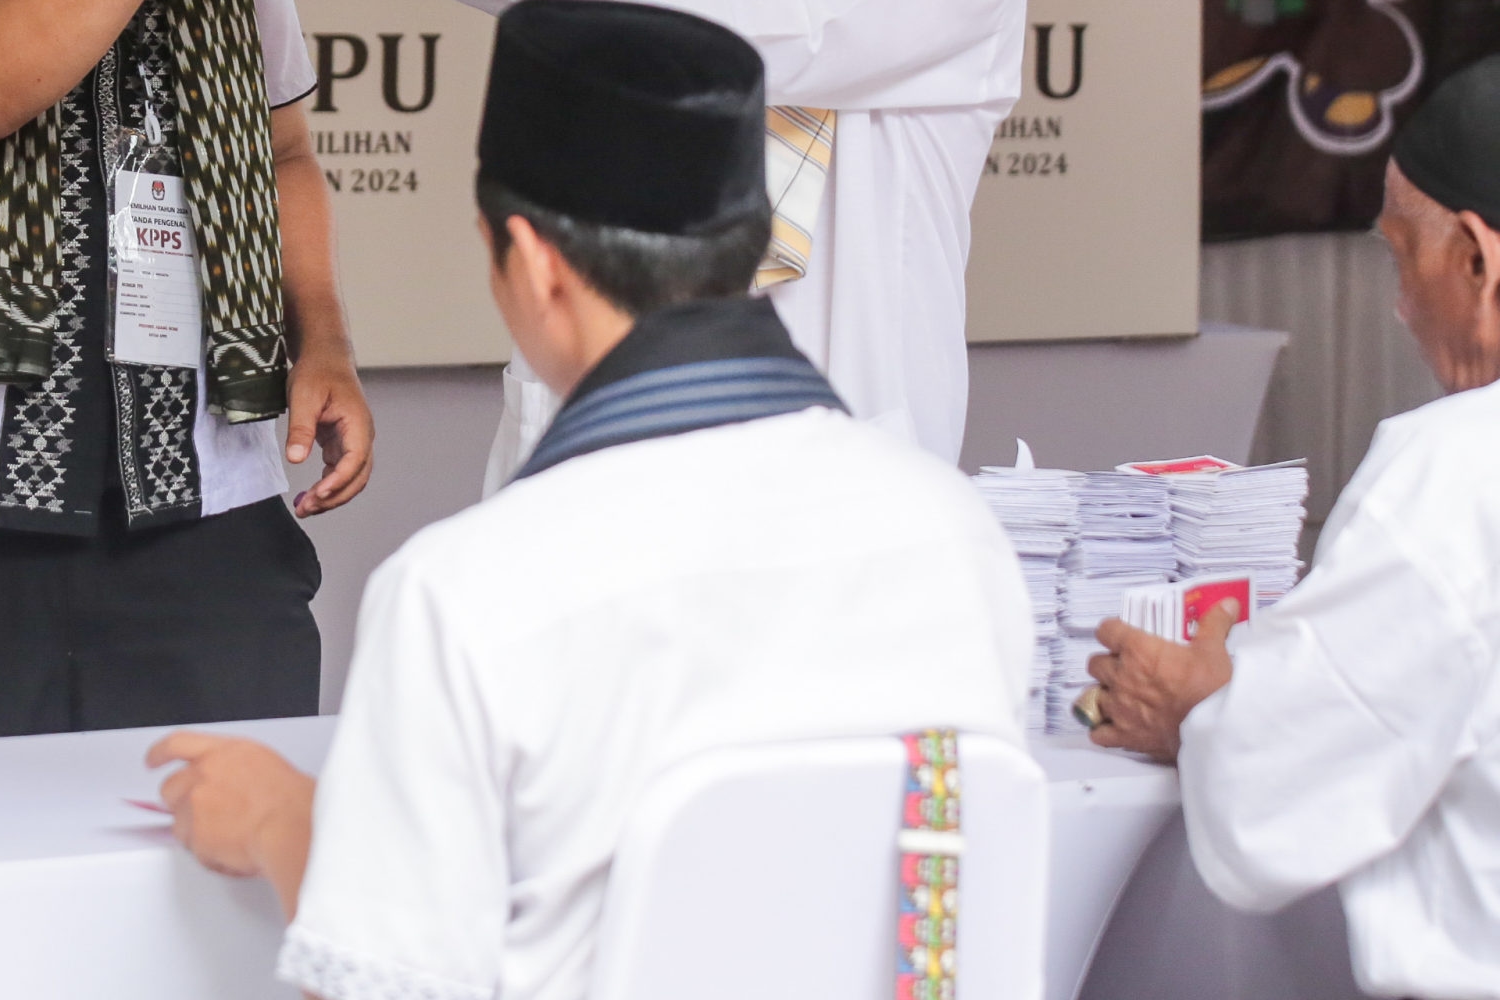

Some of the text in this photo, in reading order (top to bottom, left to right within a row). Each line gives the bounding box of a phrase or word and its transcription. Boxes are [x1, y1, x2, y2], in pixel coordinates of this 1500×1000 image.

[303, 33, 442, 113] PU
[995, 116, 1063, 139] IHAN
[310, 131, 413, 154] ILIHAN
[1006, 153, 1069, 175] 2024
[351, 169, 418, 192] 2024
[153, 217, 187, 228] PENGENAL
[137, 227, 182, 250] KPPS
